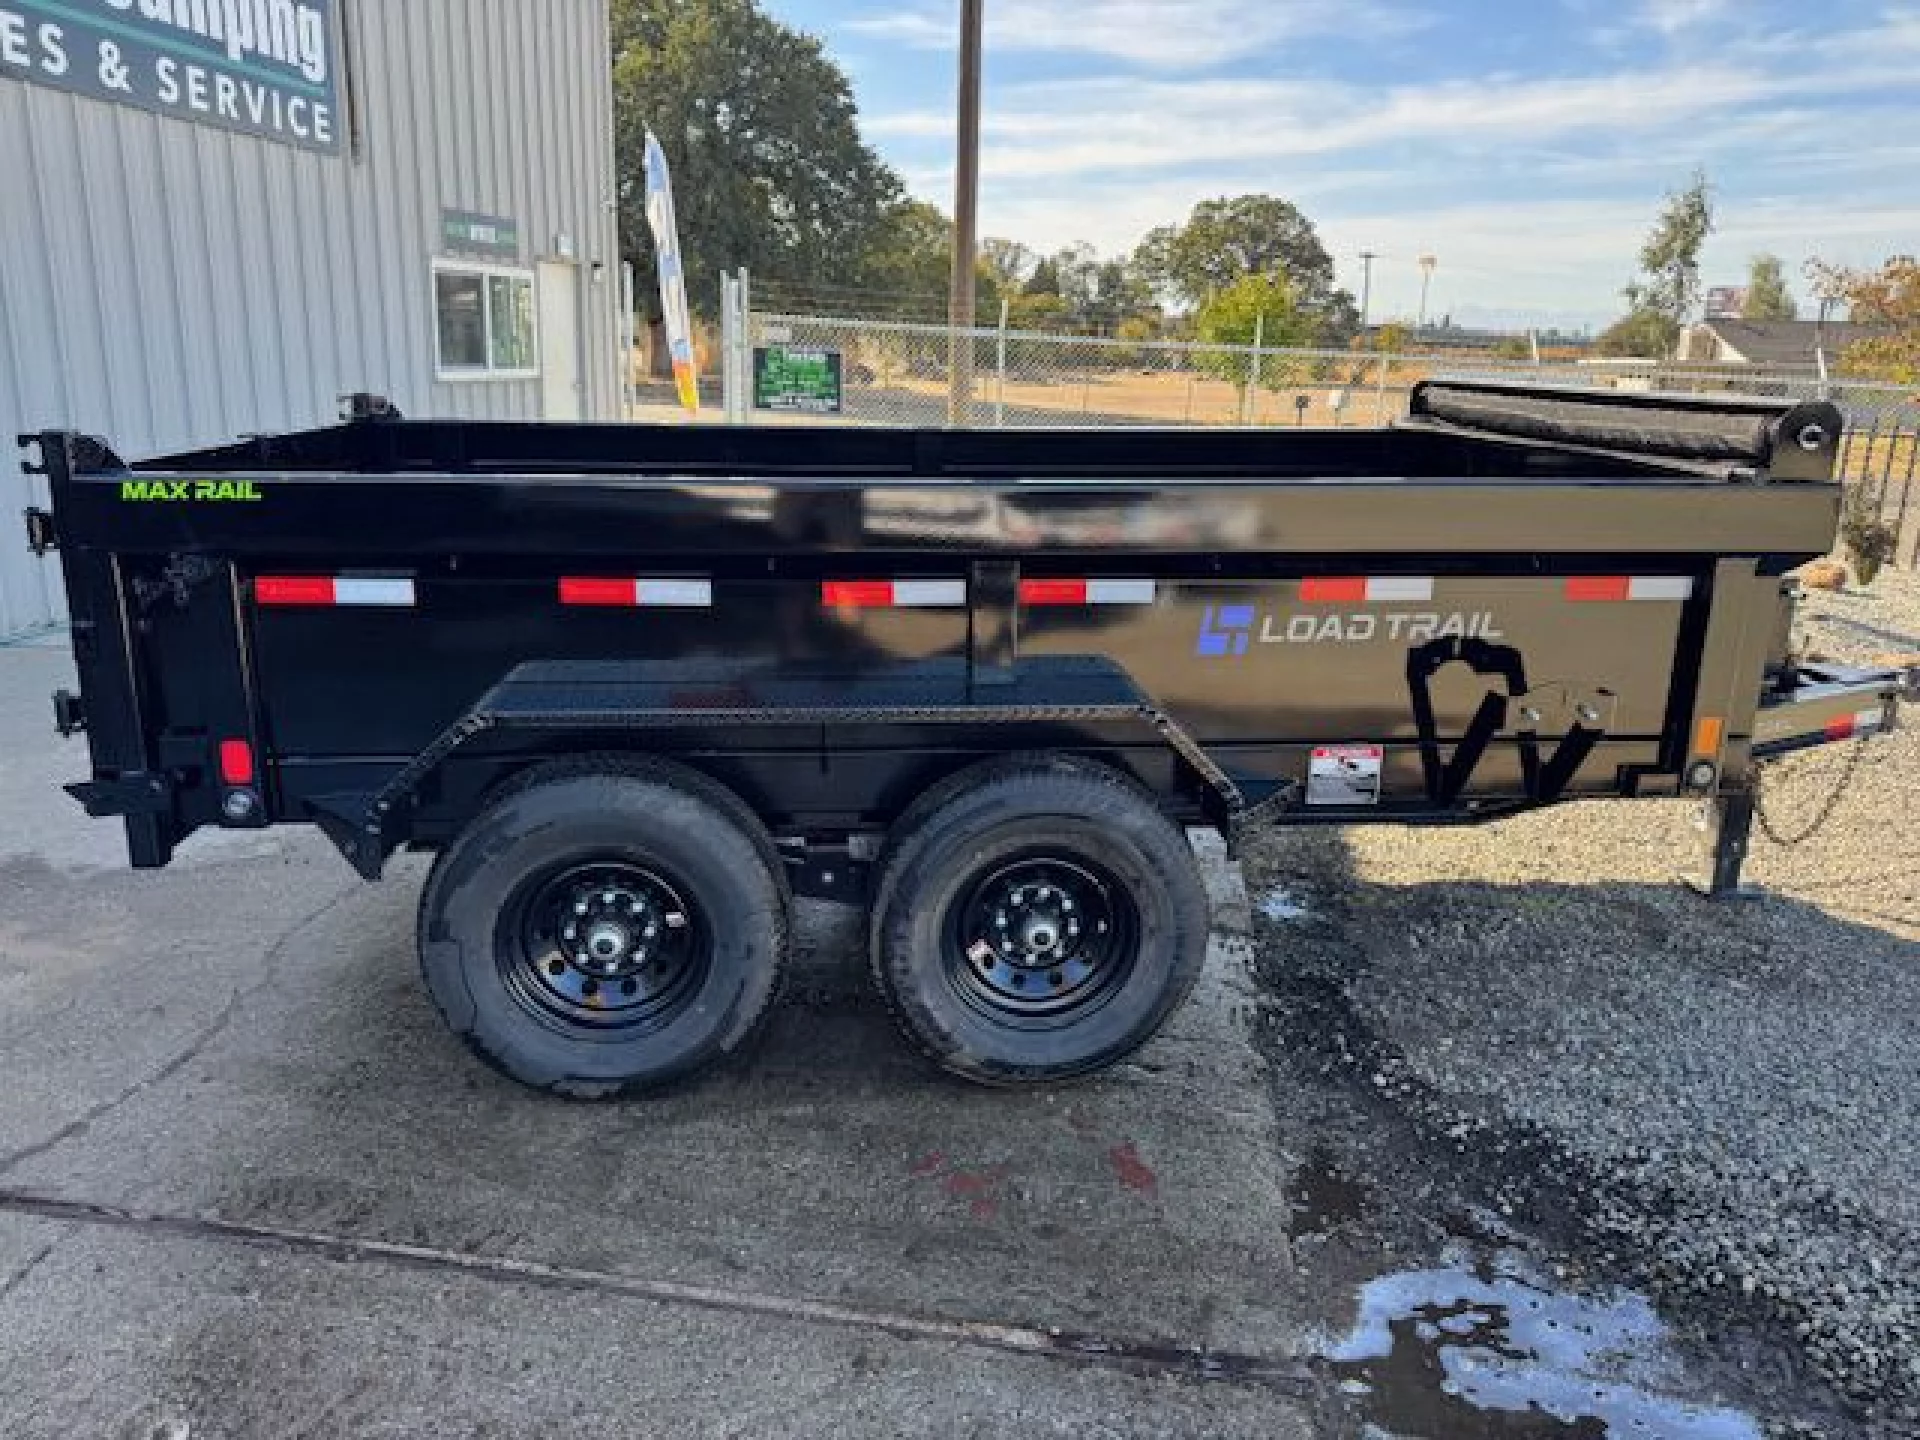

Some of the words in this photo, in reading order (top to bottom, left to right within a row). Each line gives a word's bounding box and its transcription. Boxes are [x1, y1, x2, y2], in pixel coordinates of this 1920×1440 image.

[98, 41, 133, 93] &
[155, 56, 332, 142] SERVICE
[122, 481, 189, 500] MAX
[195, 481, 262, 500] RAIL
[1260, 614, 1376, 642] LOAD
[1386, 611, 1504, 640] TRAIL
